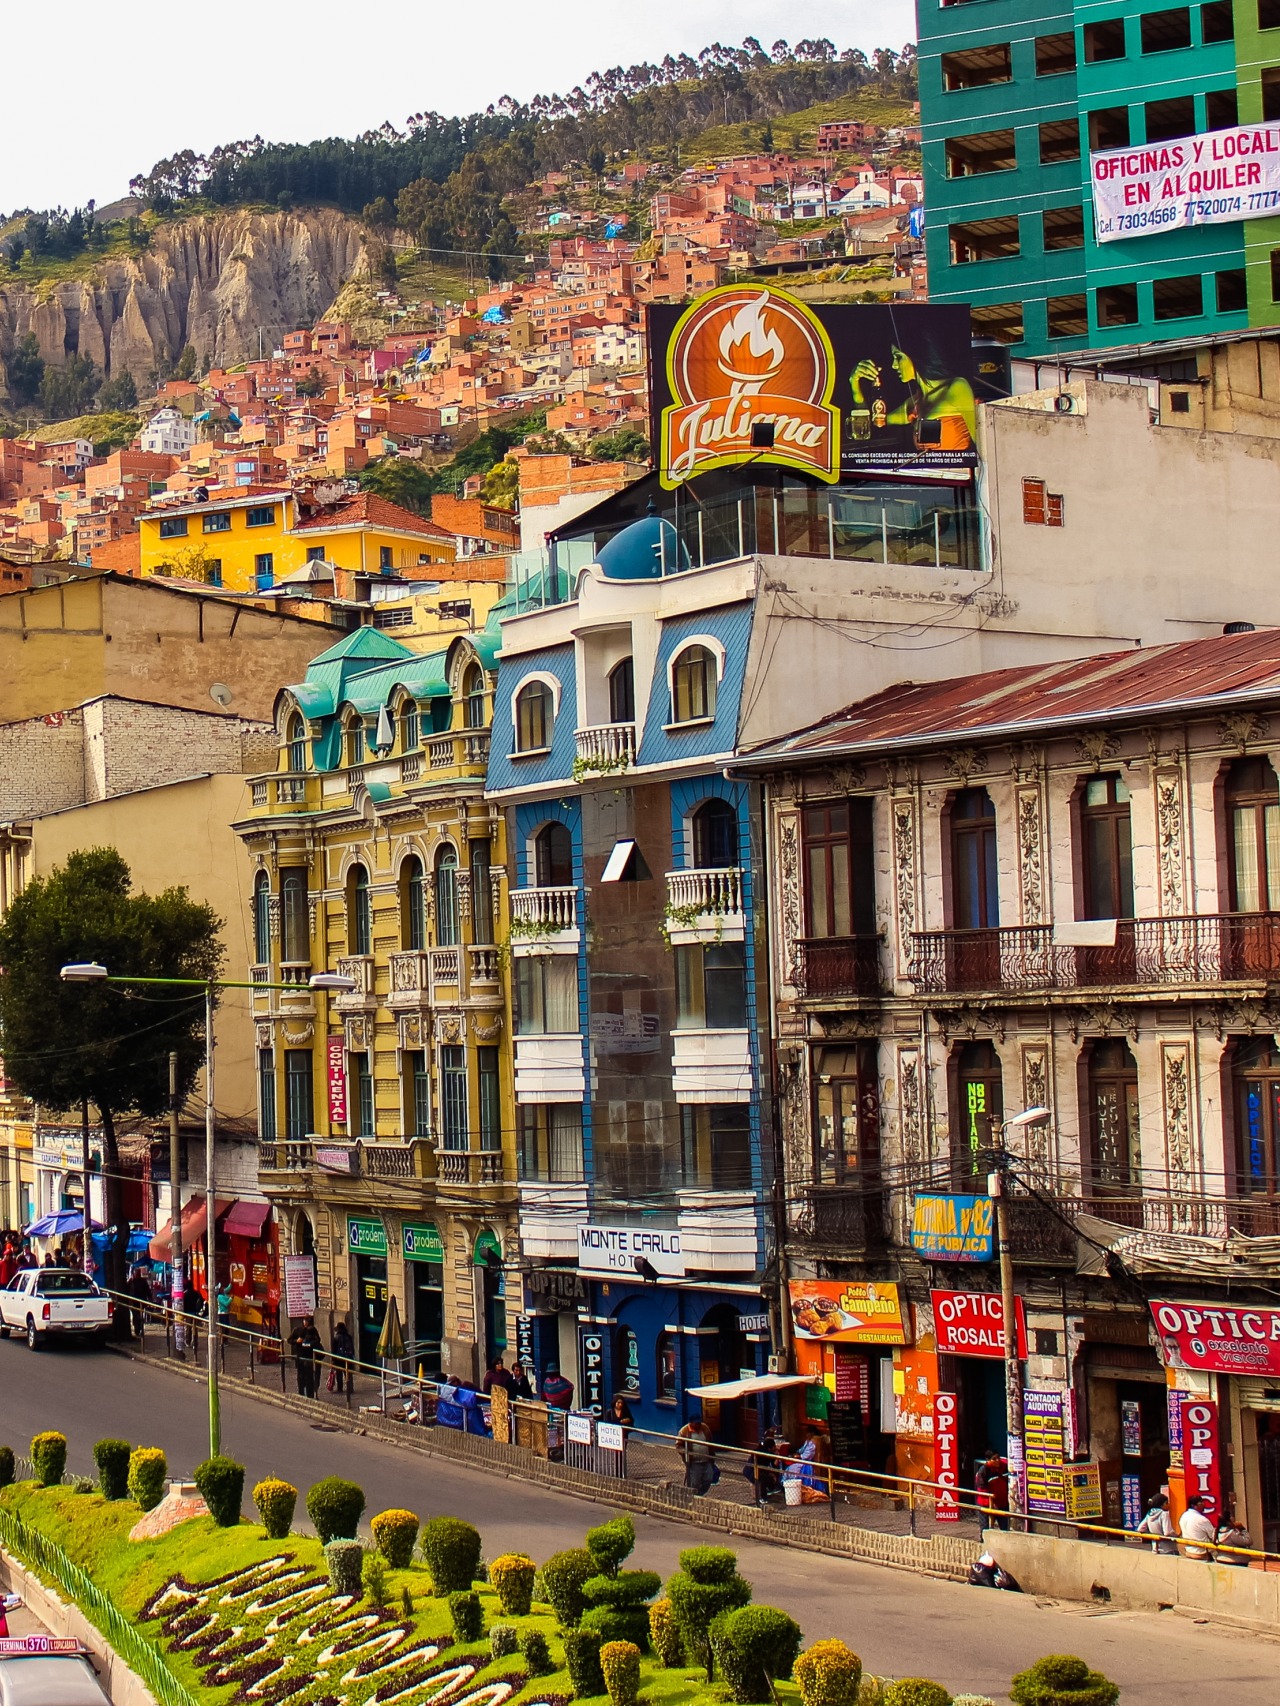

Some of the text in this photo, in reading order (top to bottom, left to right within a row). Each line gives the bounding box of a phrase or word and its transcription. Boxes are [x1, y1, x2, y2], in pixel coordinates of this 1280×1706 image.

[1095, 128, 1280, 181] OFICINAS Y LOCAL
[1124, 162, 1261, 207] EN ALQUILER
[1099, 219, 1115, 234] Cel.
[329, 1045, 344, 1121] CONTINENTAL
[581, 1229, 681, 1254] MONTE CARLO
[913, 1235, 925, 1249] DE
[608, 1253, 648, 1268] HOT
[531, 1272, 585, 1298] OPTICA
[840, 1294, 896, 1317] Campeño
[939, 1294, 1005, 1322] OPTIC
[740, 1315, 771, 1331] HOTEL
[518, 1316, 532, 1362] OPTICA
[858, 1333, 902, 1343] RESTAURANTE
[947, 1326, 1006, 1348] ROSALE
[1207, 1339, 1269, 1355] excelente
[585, 1337, 603, 1417] OPTIC
[1023, 1392, 1061, 1404] CONTADOR
[1027, 1402, 1058, 1413] AUDITOR
[1169, 1392, 1180, 1445] NOTARIA
[600, 1426, 620, 1437] HOTEL
[600, 1436, 620, 1446] CARLO
[936, 1395, 956, 1508] OPTICA
[1188, 1405, 1216, 1514] OPIC
[1122, 1477, 1134, 1529] NOTARIA
[1132, 1484, 1141, 1528] PUBLIC
[0, 1641, 26, 1651] TERMINAL
[28, 1638, 48, 1651] 370
